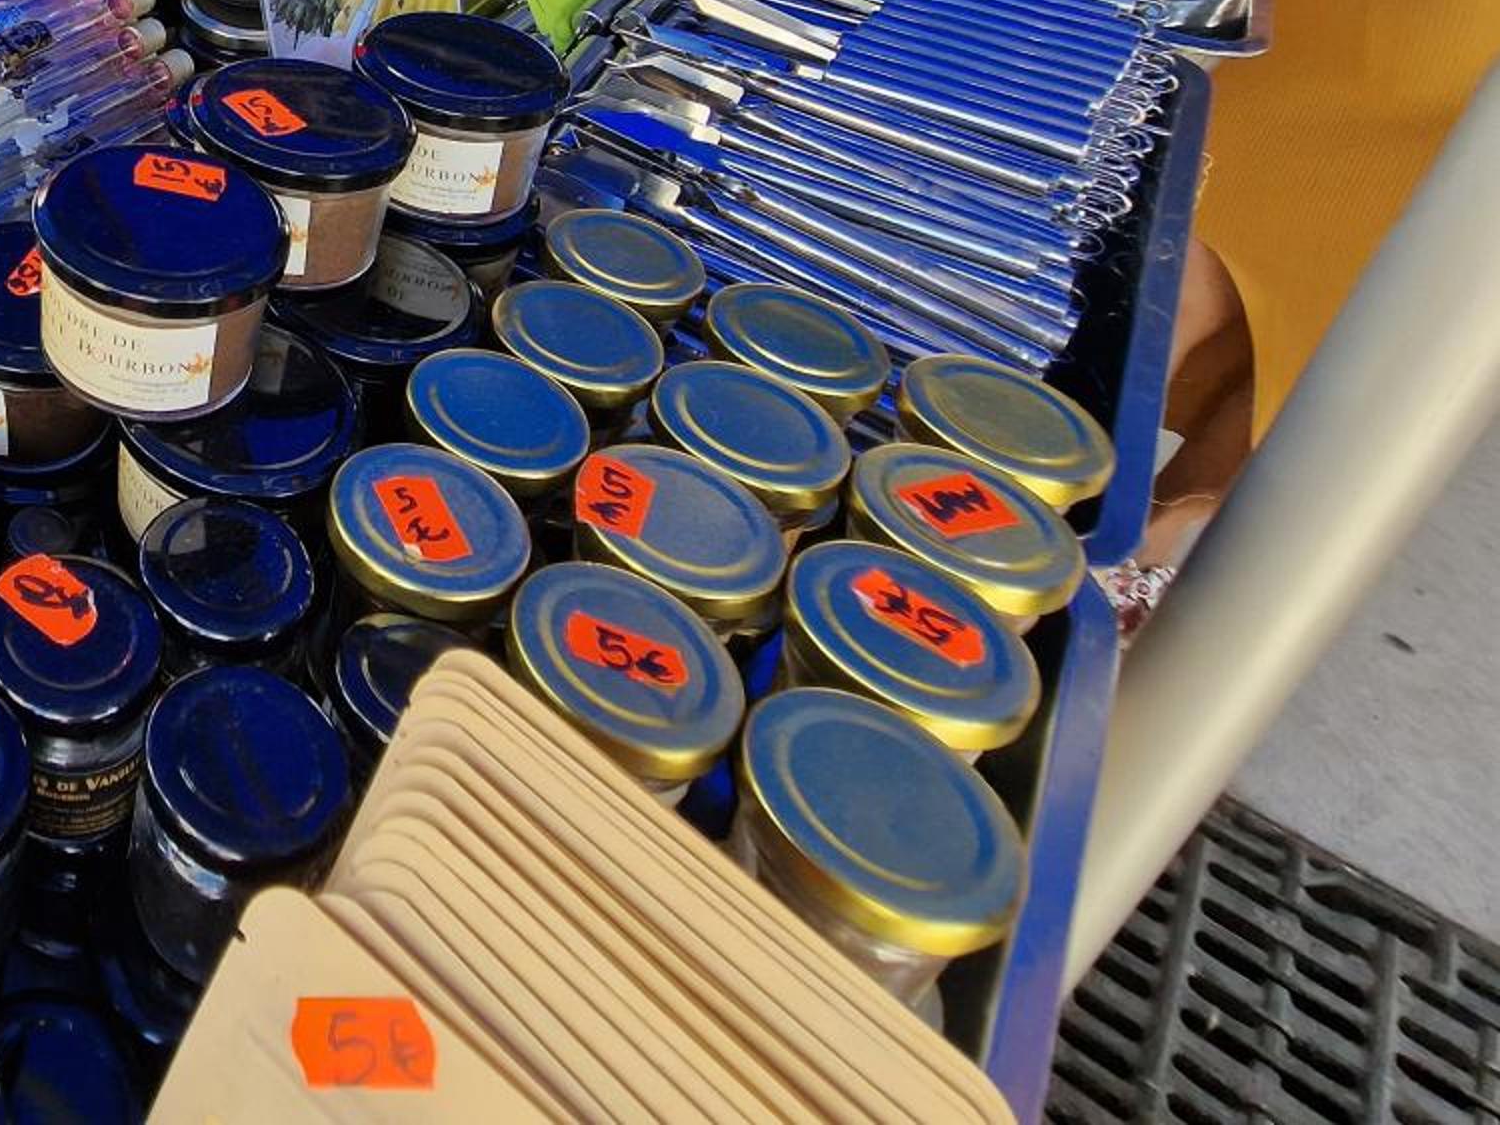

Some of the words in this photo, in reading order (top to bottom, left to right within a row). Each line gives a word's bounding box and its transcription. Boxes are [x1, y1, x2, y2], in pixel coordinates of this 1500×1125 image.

[410, 162, 479, 183] URBON
[78, 338, 192, 378] BOURBON
[112, 333, 144, 353] DE
[597, 628, 689, 684] 5€
[56, 780, 79, 793] DE
[326, 1009, 430, 1085] 5€
